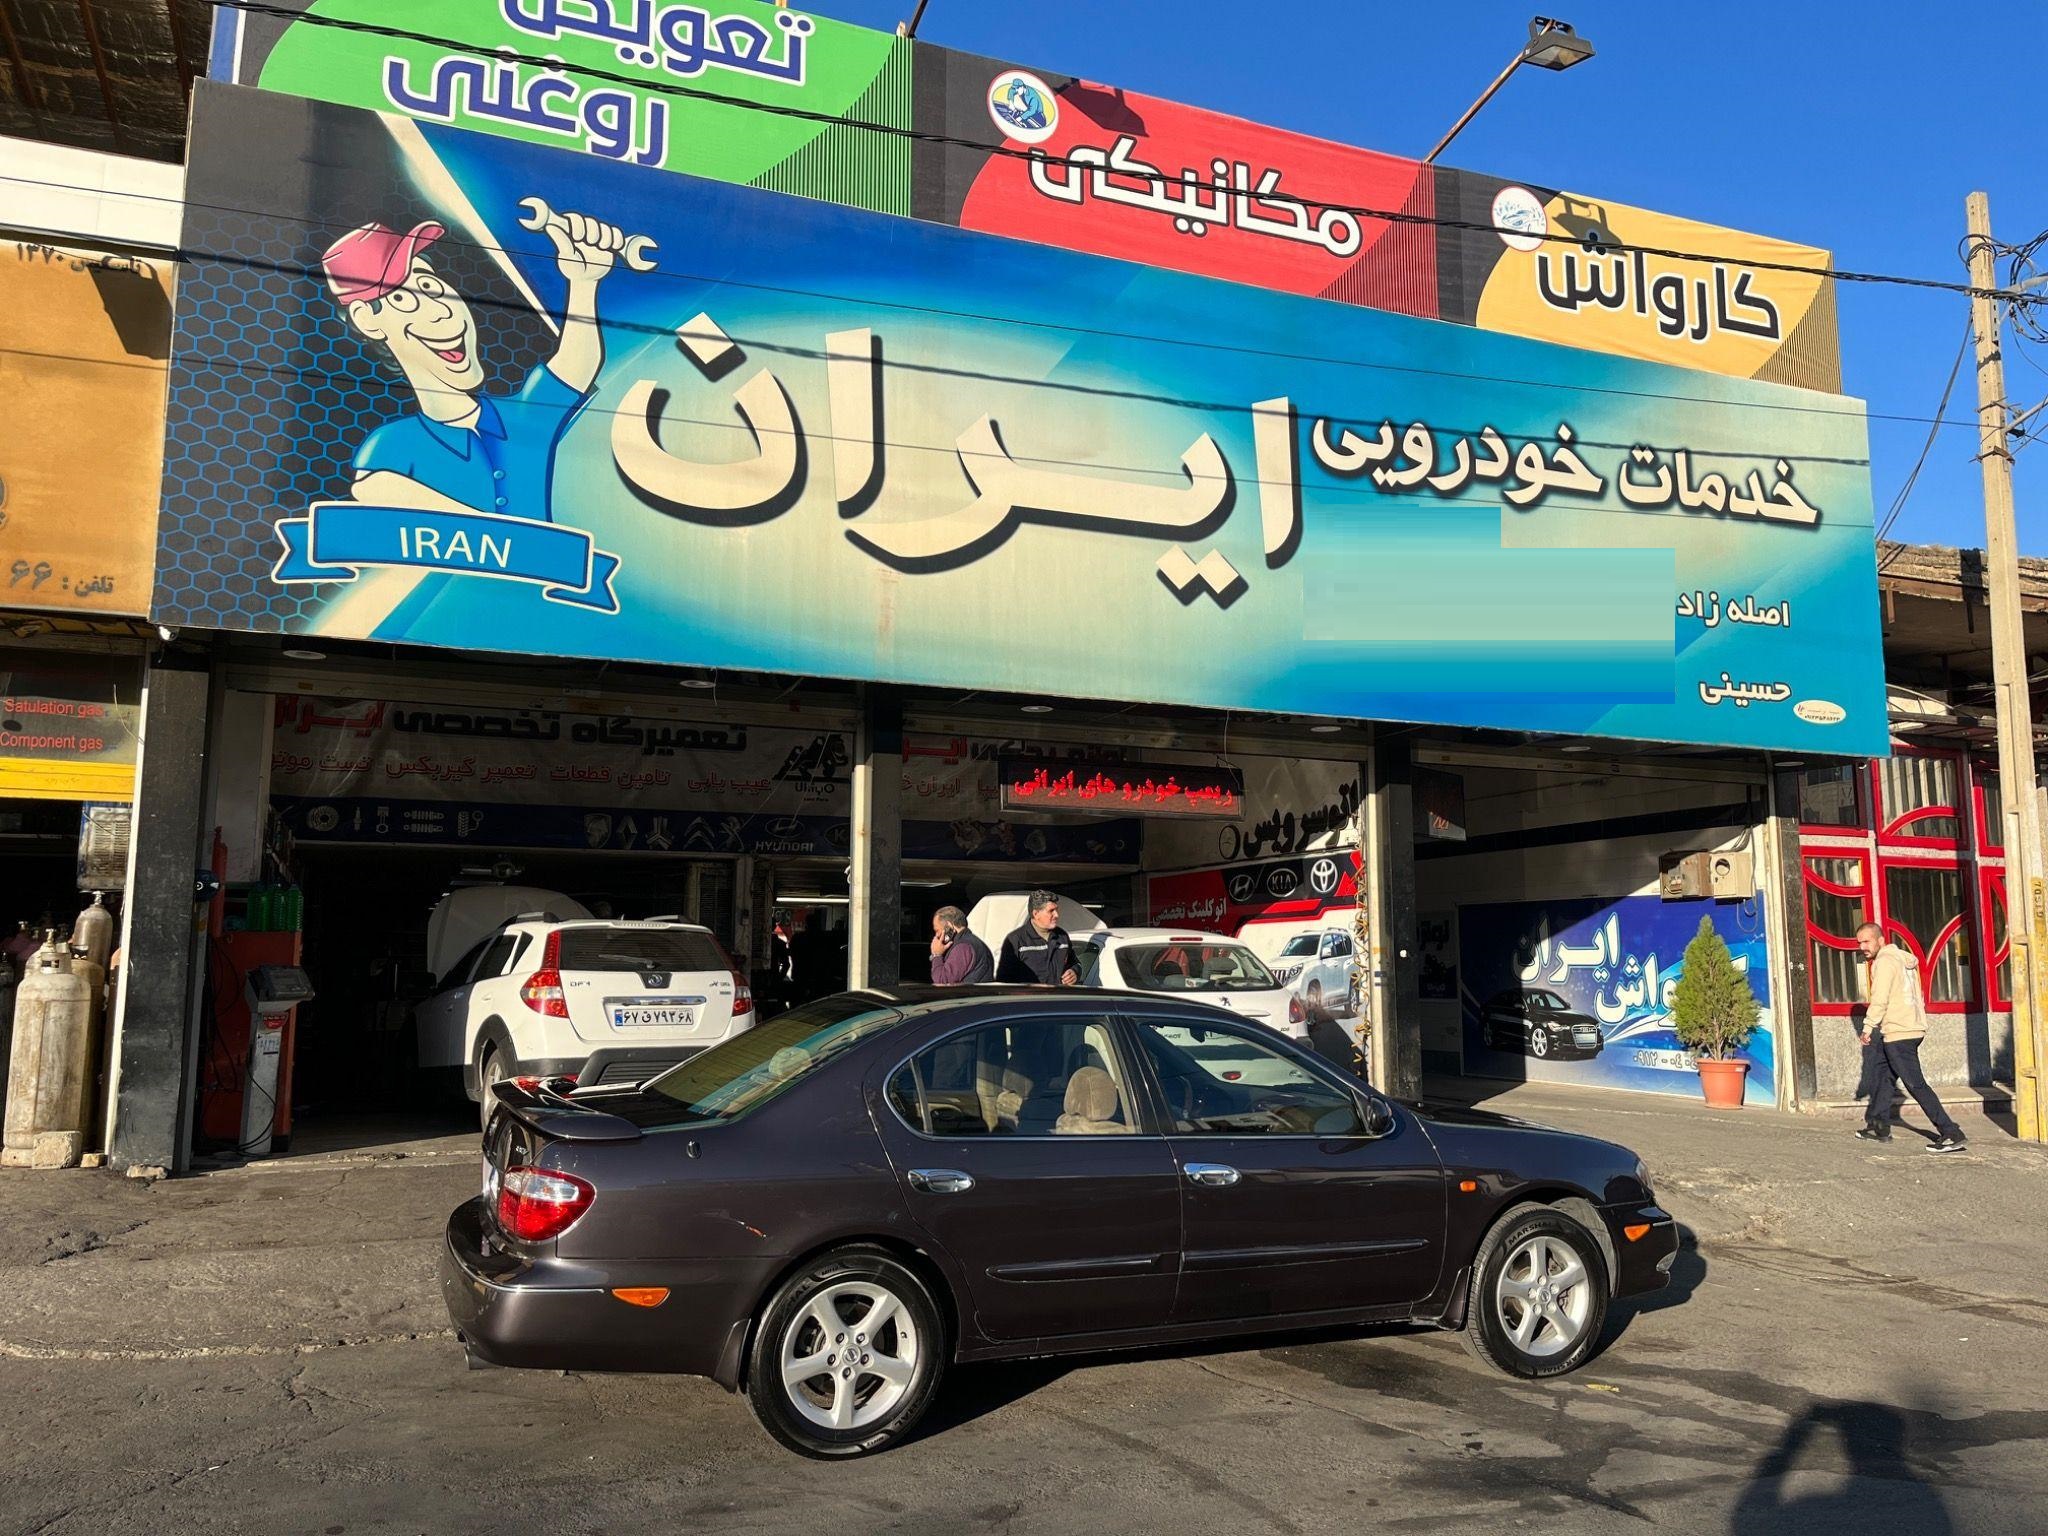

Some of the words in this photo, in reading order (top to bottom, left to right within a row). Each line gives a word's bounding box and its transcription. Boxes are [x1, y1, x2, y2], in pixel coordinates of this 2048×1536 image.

[384, 48, 668, 168] روغنی
[1028, 133, 1362, 258] مکانیکی
[1536, 229, 1781, 342] کارواش
[611, 312, 1300, 602] ایران
[1311, 416, 1604, 505] خودرویی
[1617, 444, 1820, 525] خدمات
[400, 526, 511, 568] IRAN
[75, 576, 114, 597] تلفن
[1727, 594, 1790, 628] اصله
[1699, 672, 1792, 707] حسینی
[78, 704, 104, 718] gas
[394, 709, 560, 740] تخصصی
[0, 732, 75, 751] Component
[79, 738, 103, 752] gas
[572, 716, 747, 756] تعمیرگاه
[755, 841, 815, 853] HYUNDAI
[1513, 911, 1622, 985] ایران
